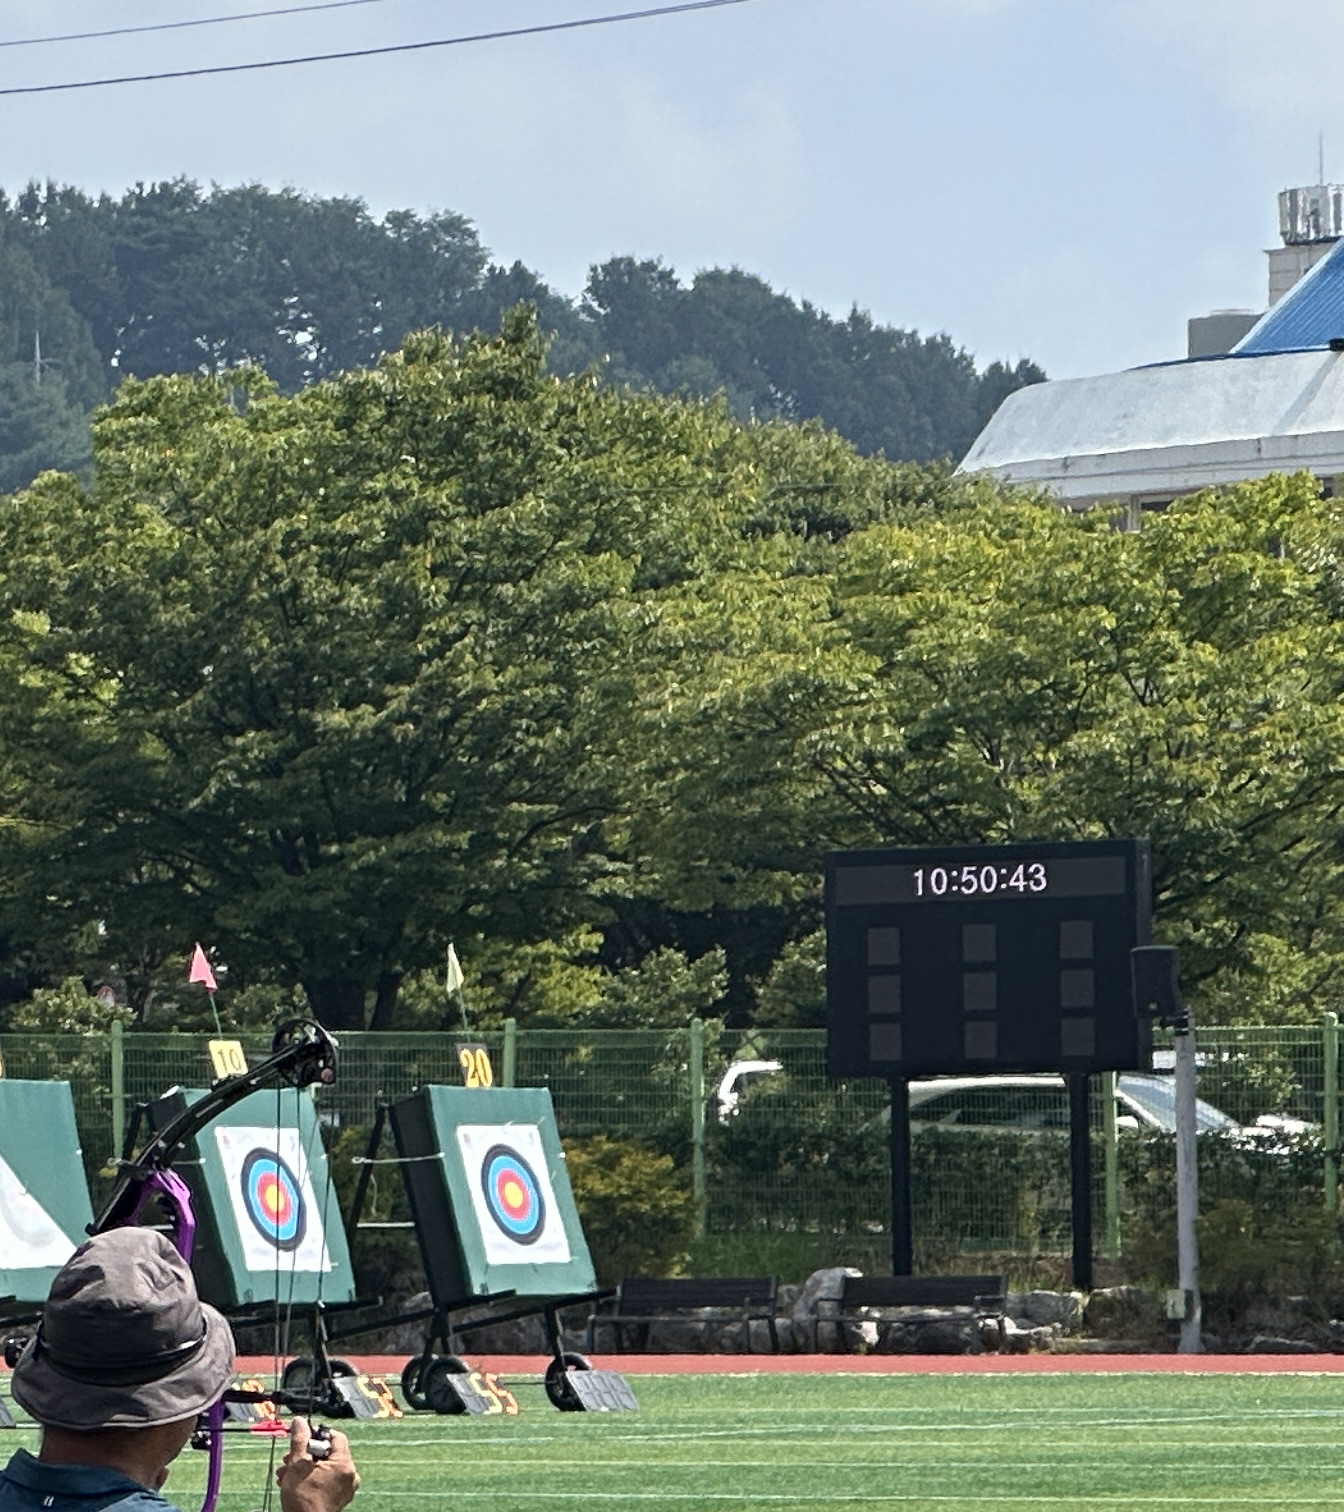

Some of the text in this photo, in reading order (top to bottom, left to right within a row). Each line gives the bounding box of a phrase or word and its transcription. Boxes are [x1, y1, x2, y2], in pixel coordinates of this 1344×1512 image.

[914, 862, 1048, 897] 10:50:43
[460, 1048, 493, 1088] 20
[469, 1372, 519, 1416] 55
